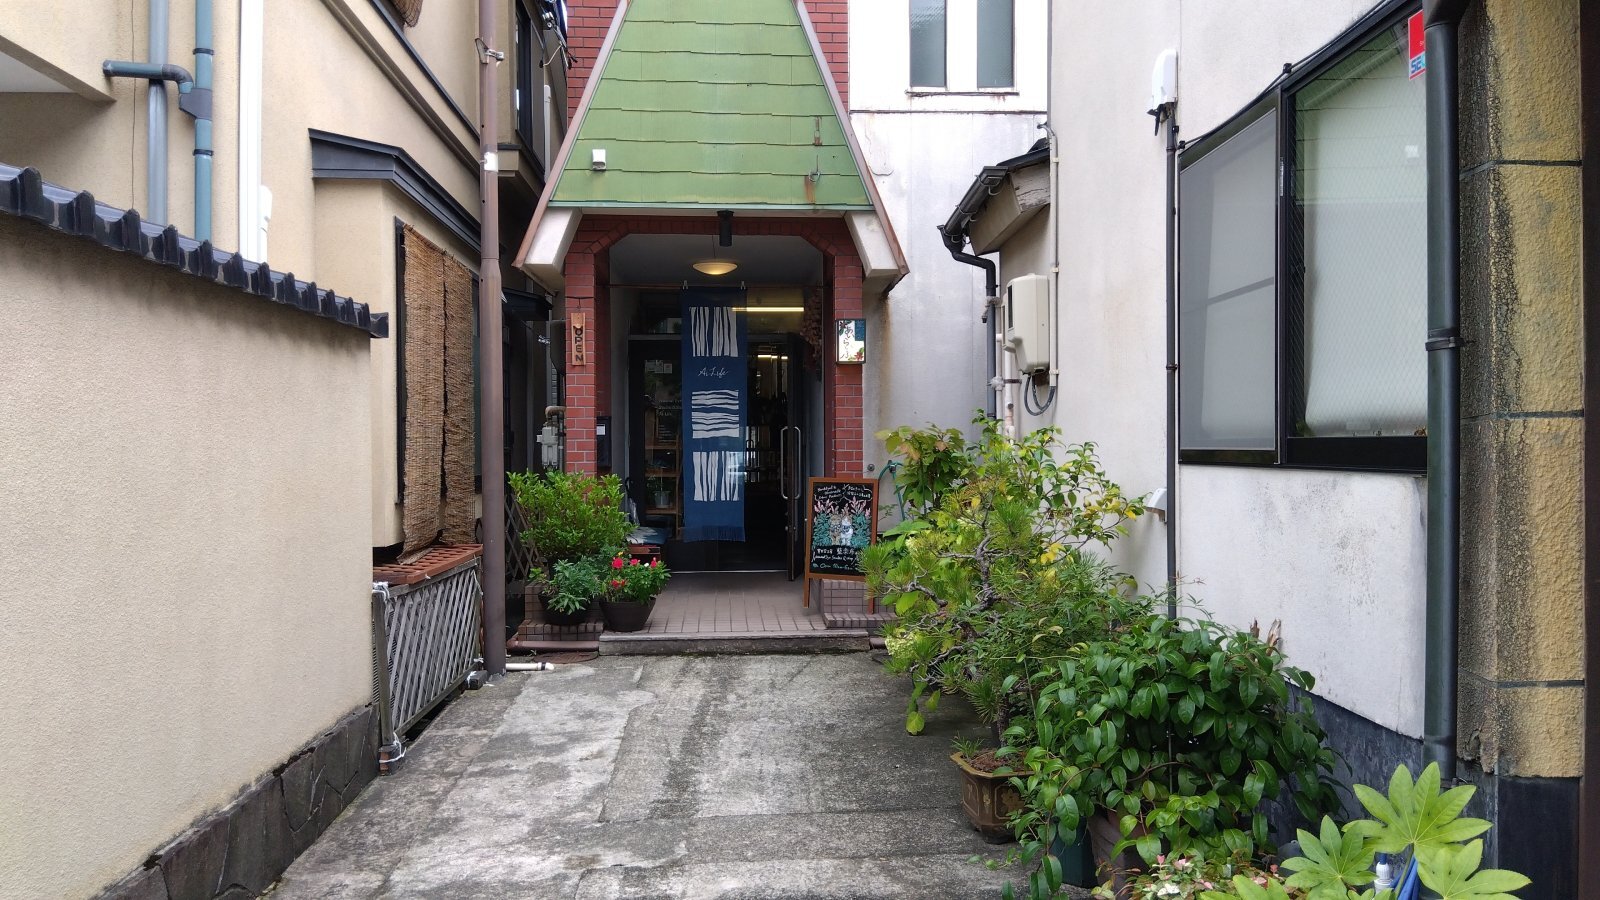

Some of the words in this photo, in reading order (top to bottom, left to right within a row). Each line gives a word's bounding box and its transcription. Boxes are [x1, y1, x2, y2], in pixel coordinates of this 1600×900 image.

[574, 327, 584, 362] OPEN
[698, 367, 708, 377] Ai
[710, 366, 728, 379] Life
